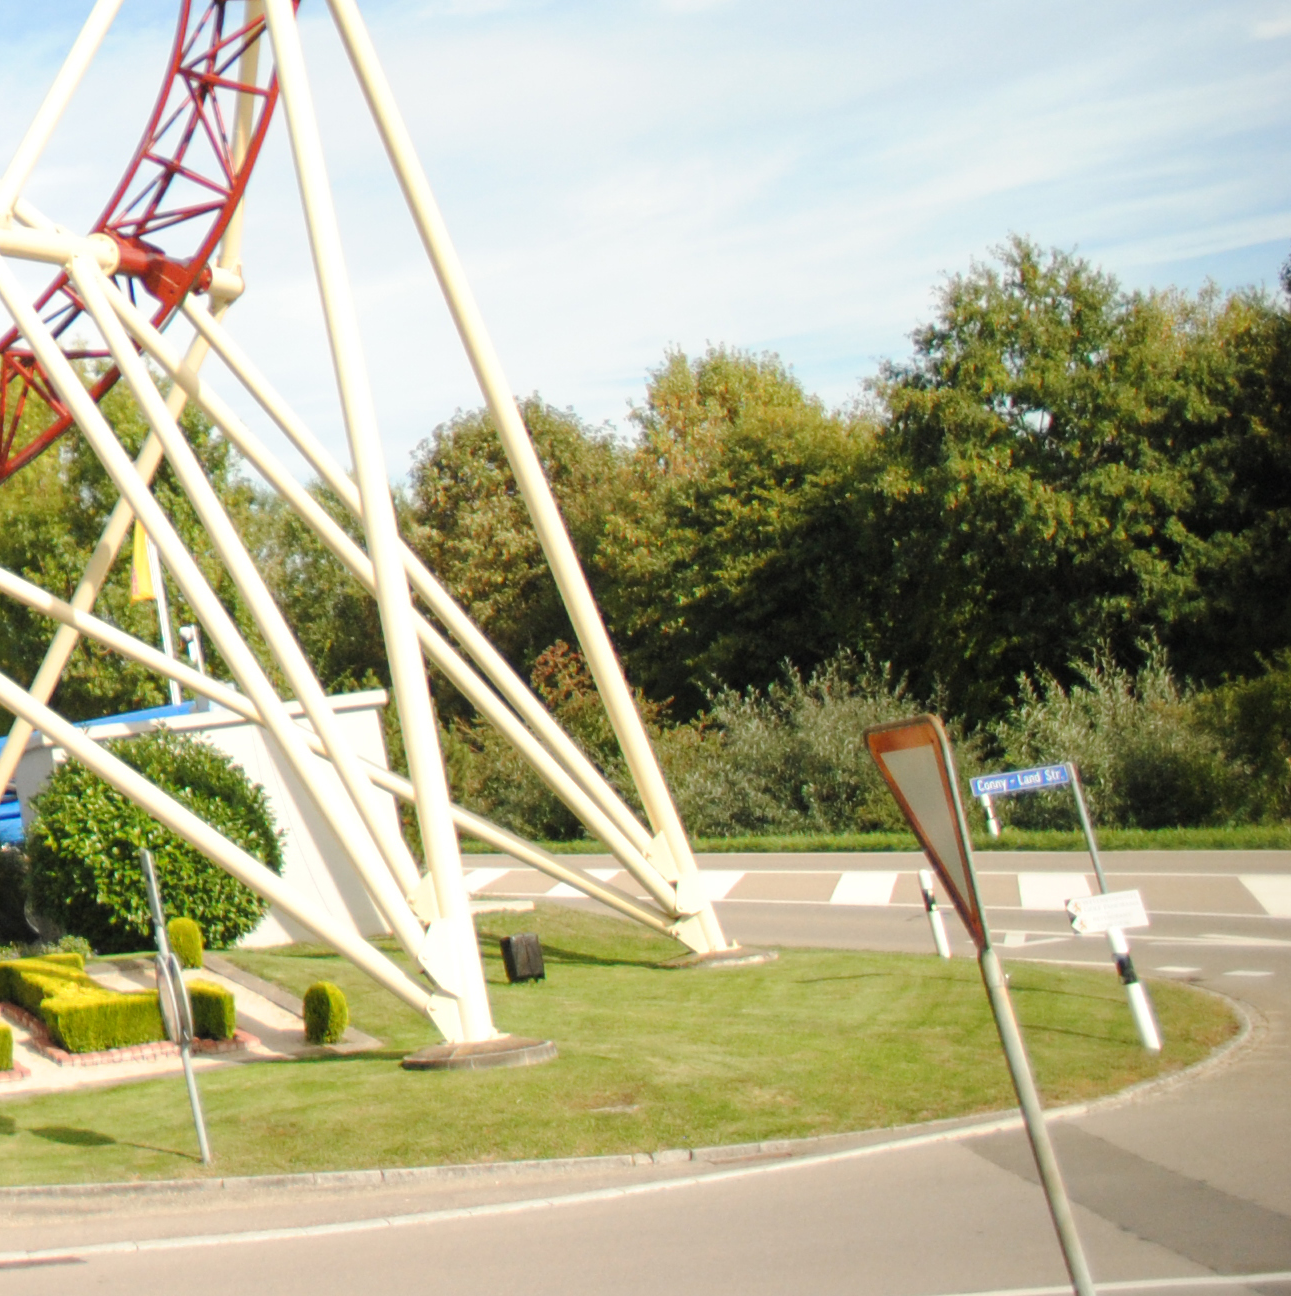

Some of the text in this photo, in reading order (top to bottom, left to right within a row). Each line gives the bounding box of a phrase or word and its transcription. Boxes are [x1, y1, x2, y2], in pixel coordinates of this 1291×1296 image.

[976, 778, 1008, 791] Conny
[1017, 773, 1041, 786] Land
[1044, 769, 1065, 781] Str.
